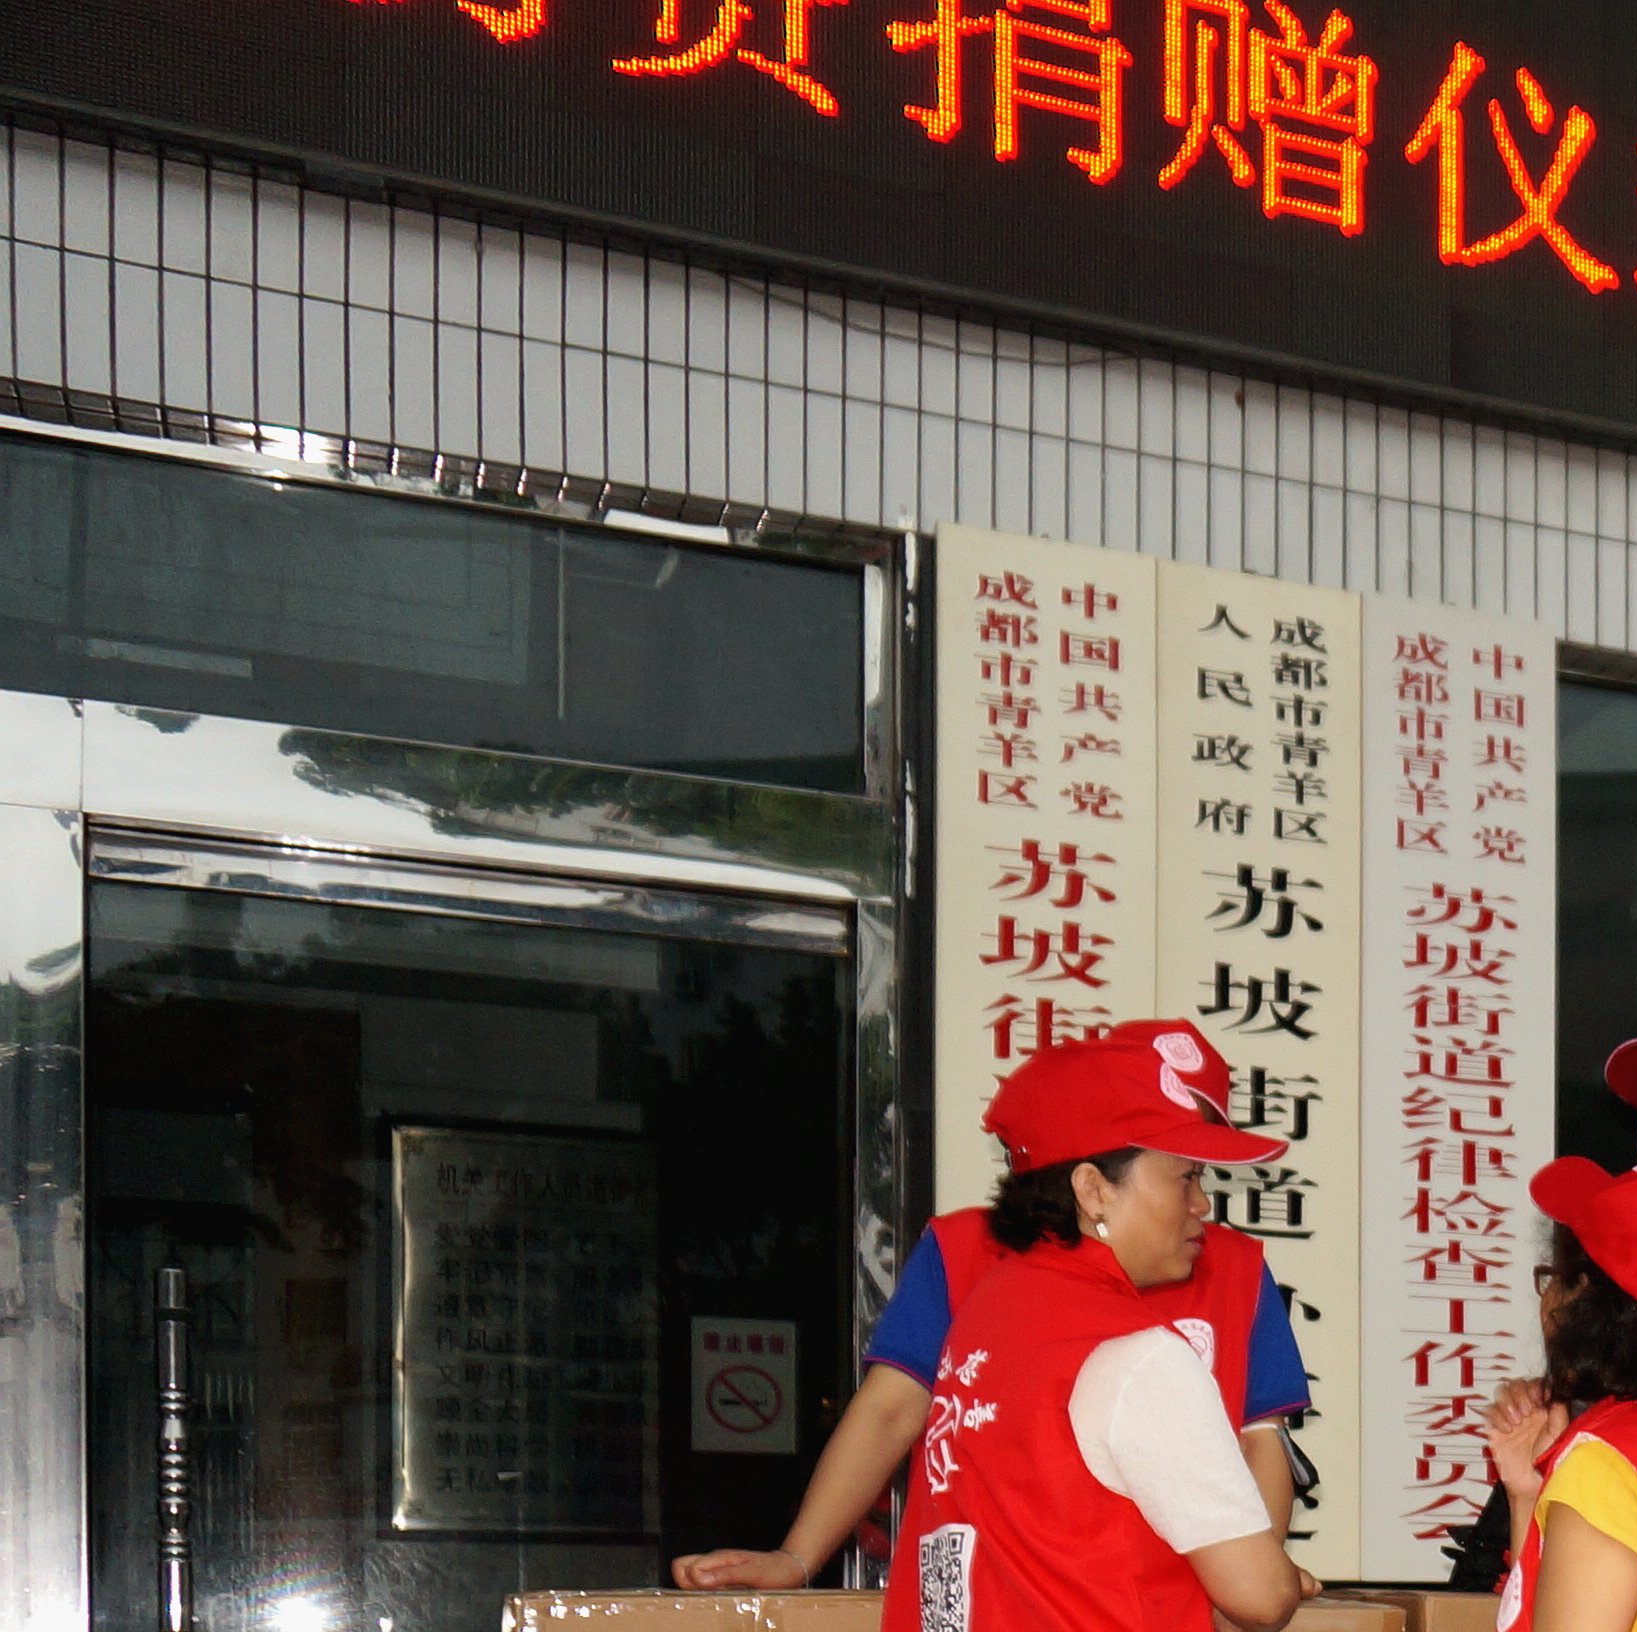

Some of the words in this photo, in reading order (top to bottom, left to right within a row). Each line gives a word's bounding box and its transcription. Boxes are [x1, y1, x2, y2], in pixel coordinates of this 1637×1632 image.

[975, 570, 1041, 811] 成都市青羊区
[1059, 582, 1124, 822] 中国共产党
[1192, 604, 1255, 837] 人民政府
[1269, 614, 1330, 846] 成都市青羊区
[1394, 633, 1450, 857] 成都市青羊区
[1471, 645, 1527, 867] 中国共产党
